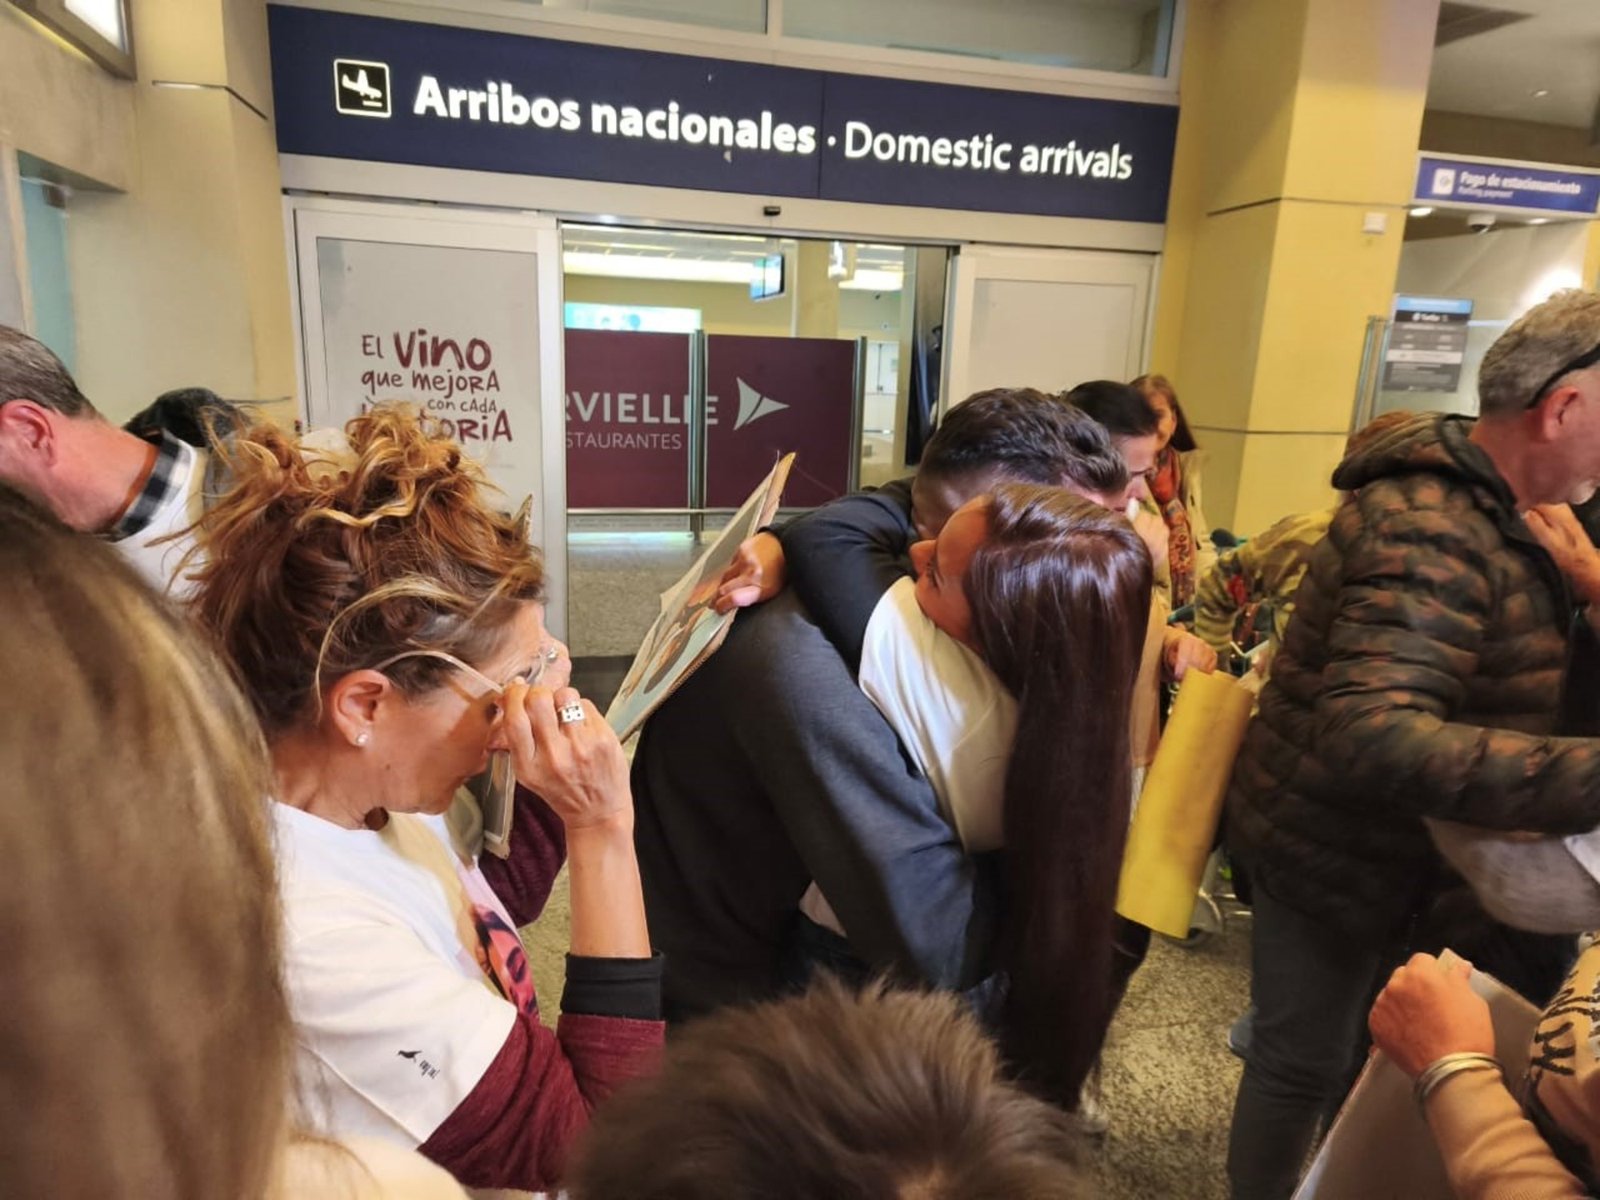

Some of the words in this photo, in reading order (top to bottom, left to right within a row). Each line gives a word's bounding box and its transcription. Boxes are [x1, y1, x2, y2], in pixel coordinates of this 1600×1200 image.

[414, 76, 581, 132] Arribos
[591, 102, 817, 155] nacionales
[844, 121, 1012, 171] Domestic
[1019, 140, 1133, 180] arrivals
[1459, 171, 1486, 188] Pago
[1487, 173, 1500, 187] de
[1502, 177, 1582, 195] estacionamiento
[362, 334, 384, 359] El
[361, 370, 403, 396] que
[427, 399, 455, 411] con
